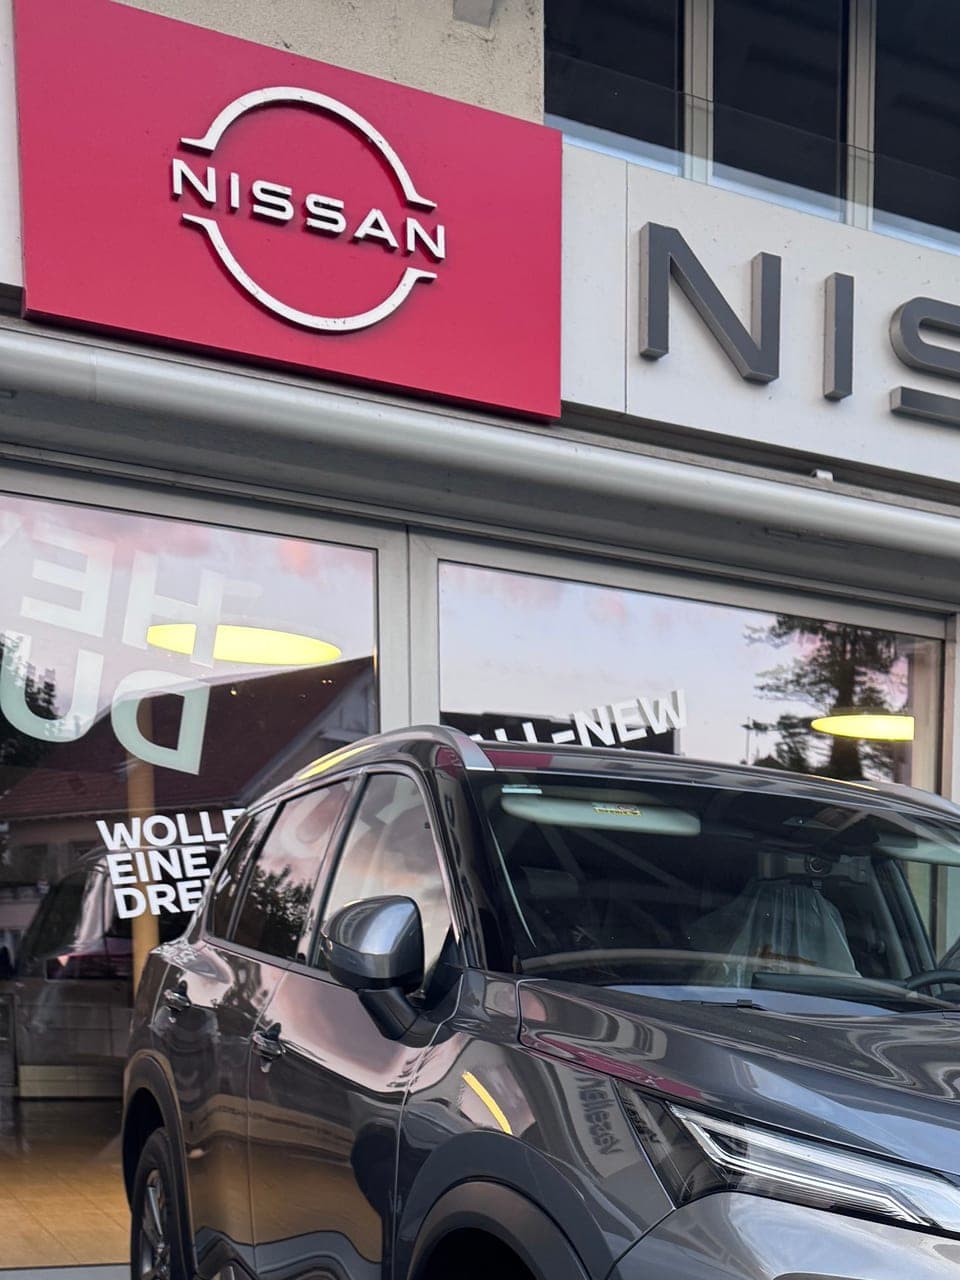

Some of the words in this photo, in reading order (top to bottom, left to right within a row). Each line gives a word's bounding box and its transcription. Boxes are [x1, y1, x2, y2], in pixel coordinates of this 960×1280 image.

[170, 157, 446, 260] NISSAN
[469, 689, 687, 748] -NEW
[106, 846, 211, 885] EINE
[113, 878, 212, 920] DRE
